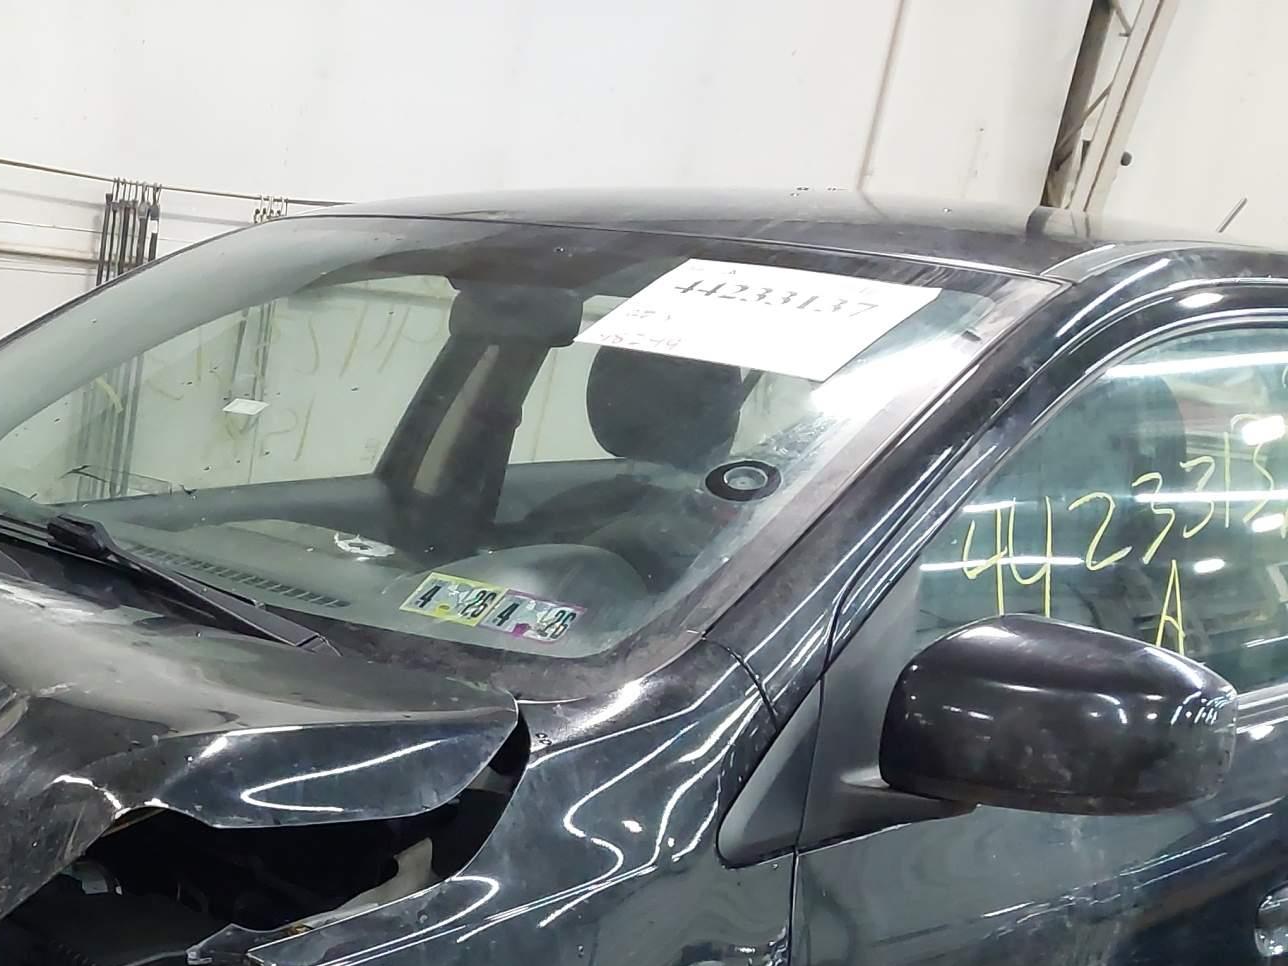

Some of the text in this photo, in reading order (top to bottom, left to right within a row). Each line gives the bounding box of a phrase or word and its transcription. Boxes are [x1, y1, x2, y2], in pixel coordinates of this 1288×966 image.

[675, 280, 879, 317] 44233137
[417, 585, 442, 608] 4
[1155, 559, 1186, 656] A
[496, 602, 521, 627] 4
